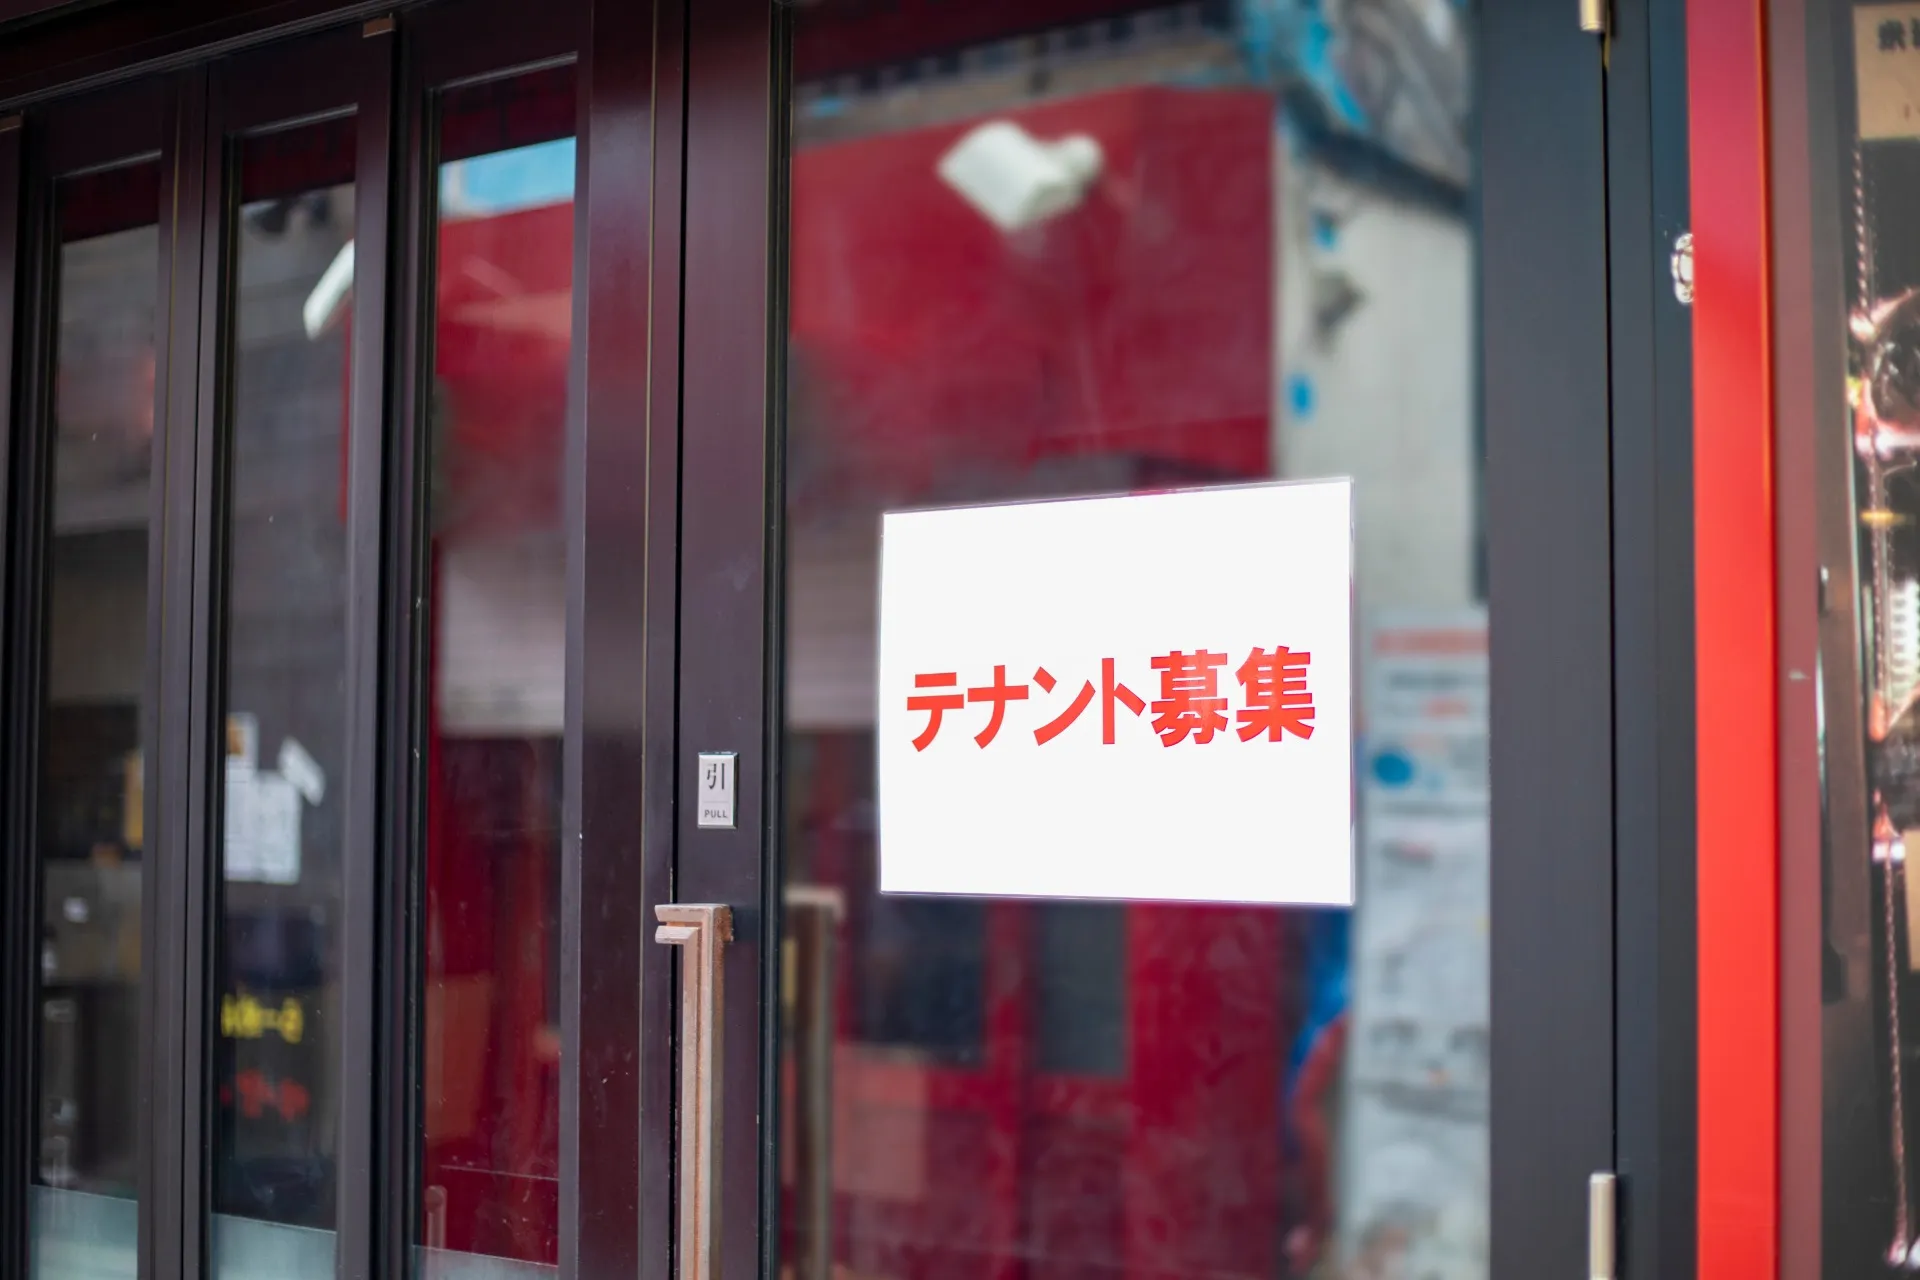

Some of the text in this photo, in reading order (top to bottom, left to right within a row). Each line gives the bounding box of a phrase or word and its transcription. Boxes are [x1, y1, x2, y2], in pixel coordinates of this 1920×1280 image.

[907, 645, 1315, 751] テナント募集
[706, 762, 726, 790] 引
[704, 809, 728, 818] PULL
